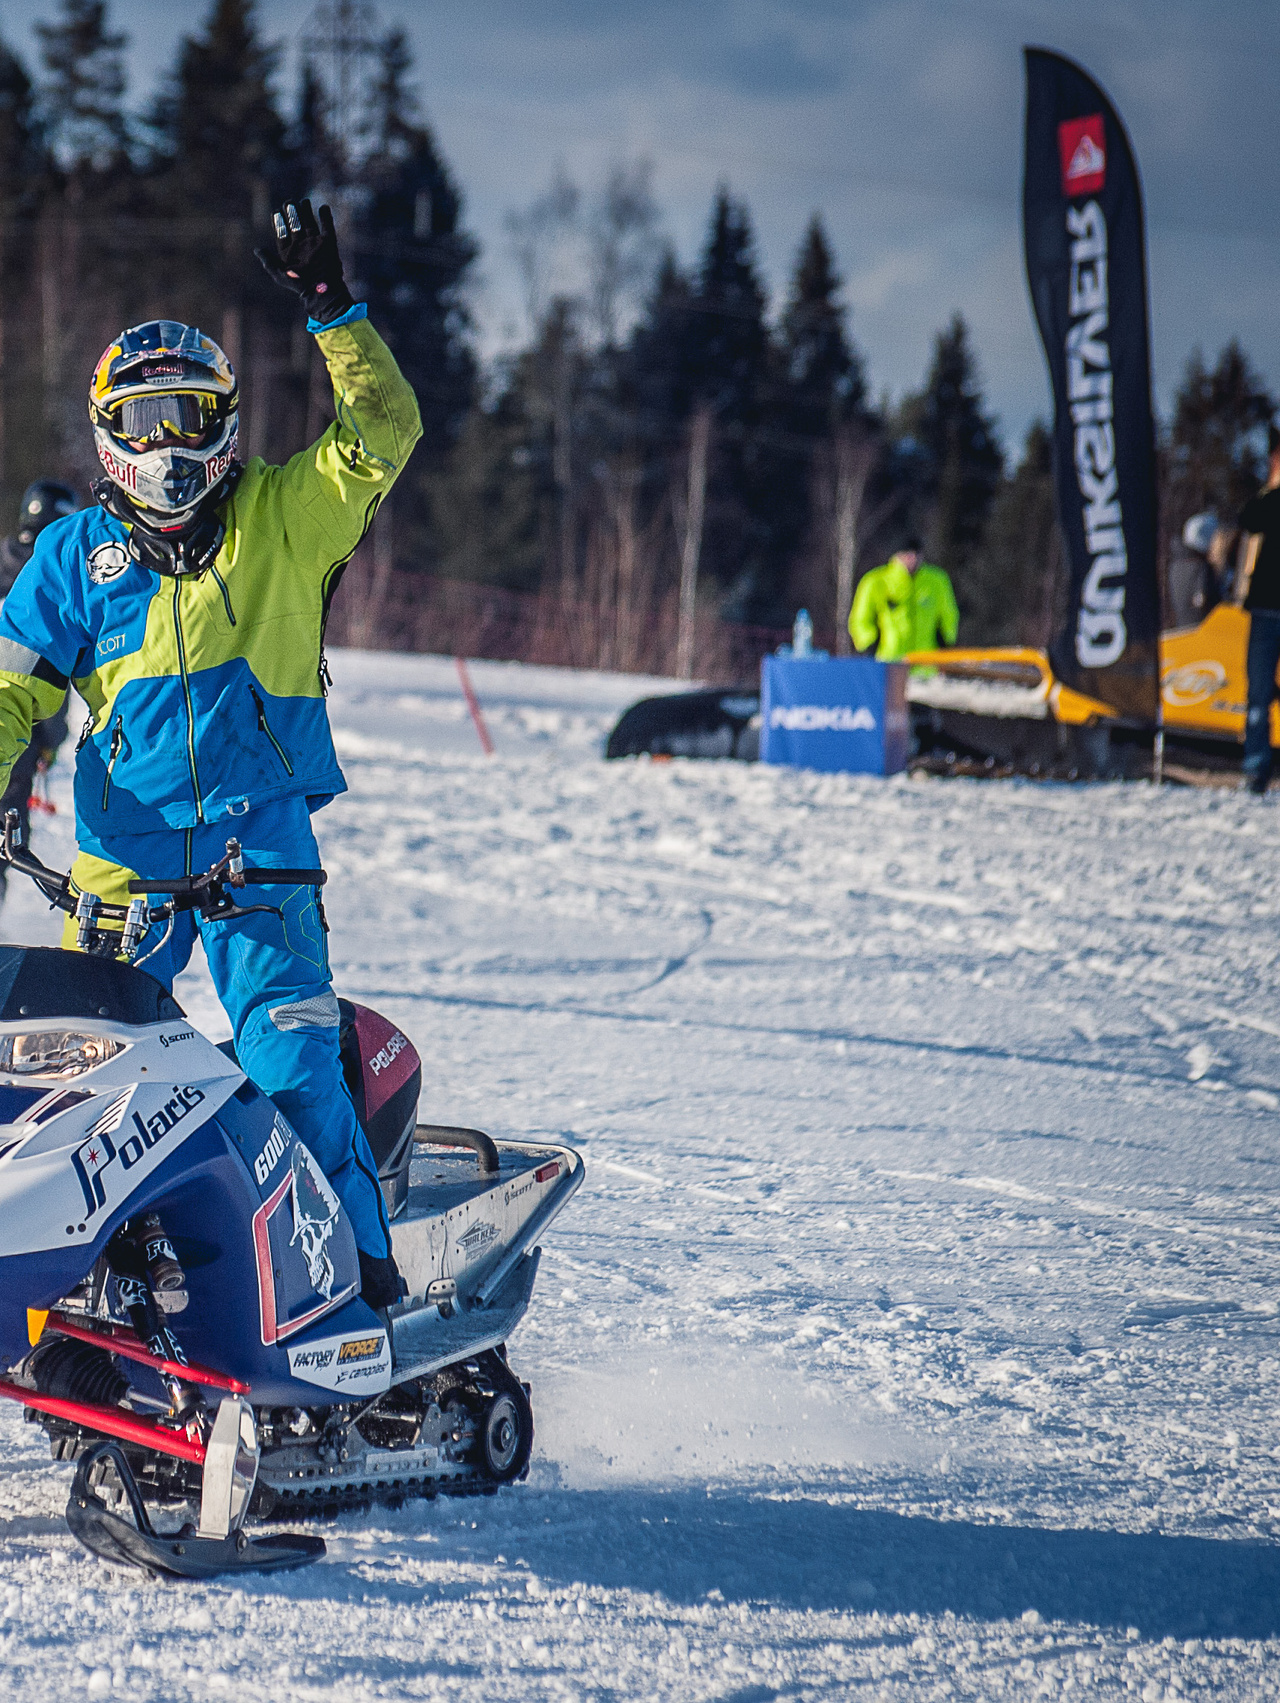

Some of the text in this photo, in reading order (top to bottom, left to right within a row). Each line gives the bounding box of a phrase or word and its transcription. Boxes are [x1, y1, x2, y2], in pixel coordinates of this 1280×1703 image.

[103, 449, 138, 491] Bull
[770, 704, 876, 732] NOKIA
[169, 1031, 196, 1044] SCOTT
[369, 1031, 408, 1077] POLARIS
[70, 1085, 206, 1221] Polaris
[254, 1126, 285, 1186] 600
[510, 1181, 534, 1200] SCOTT
[145, 1238, 178, 1262] FO
[293, 1349, 336, 1368] FACTORY
